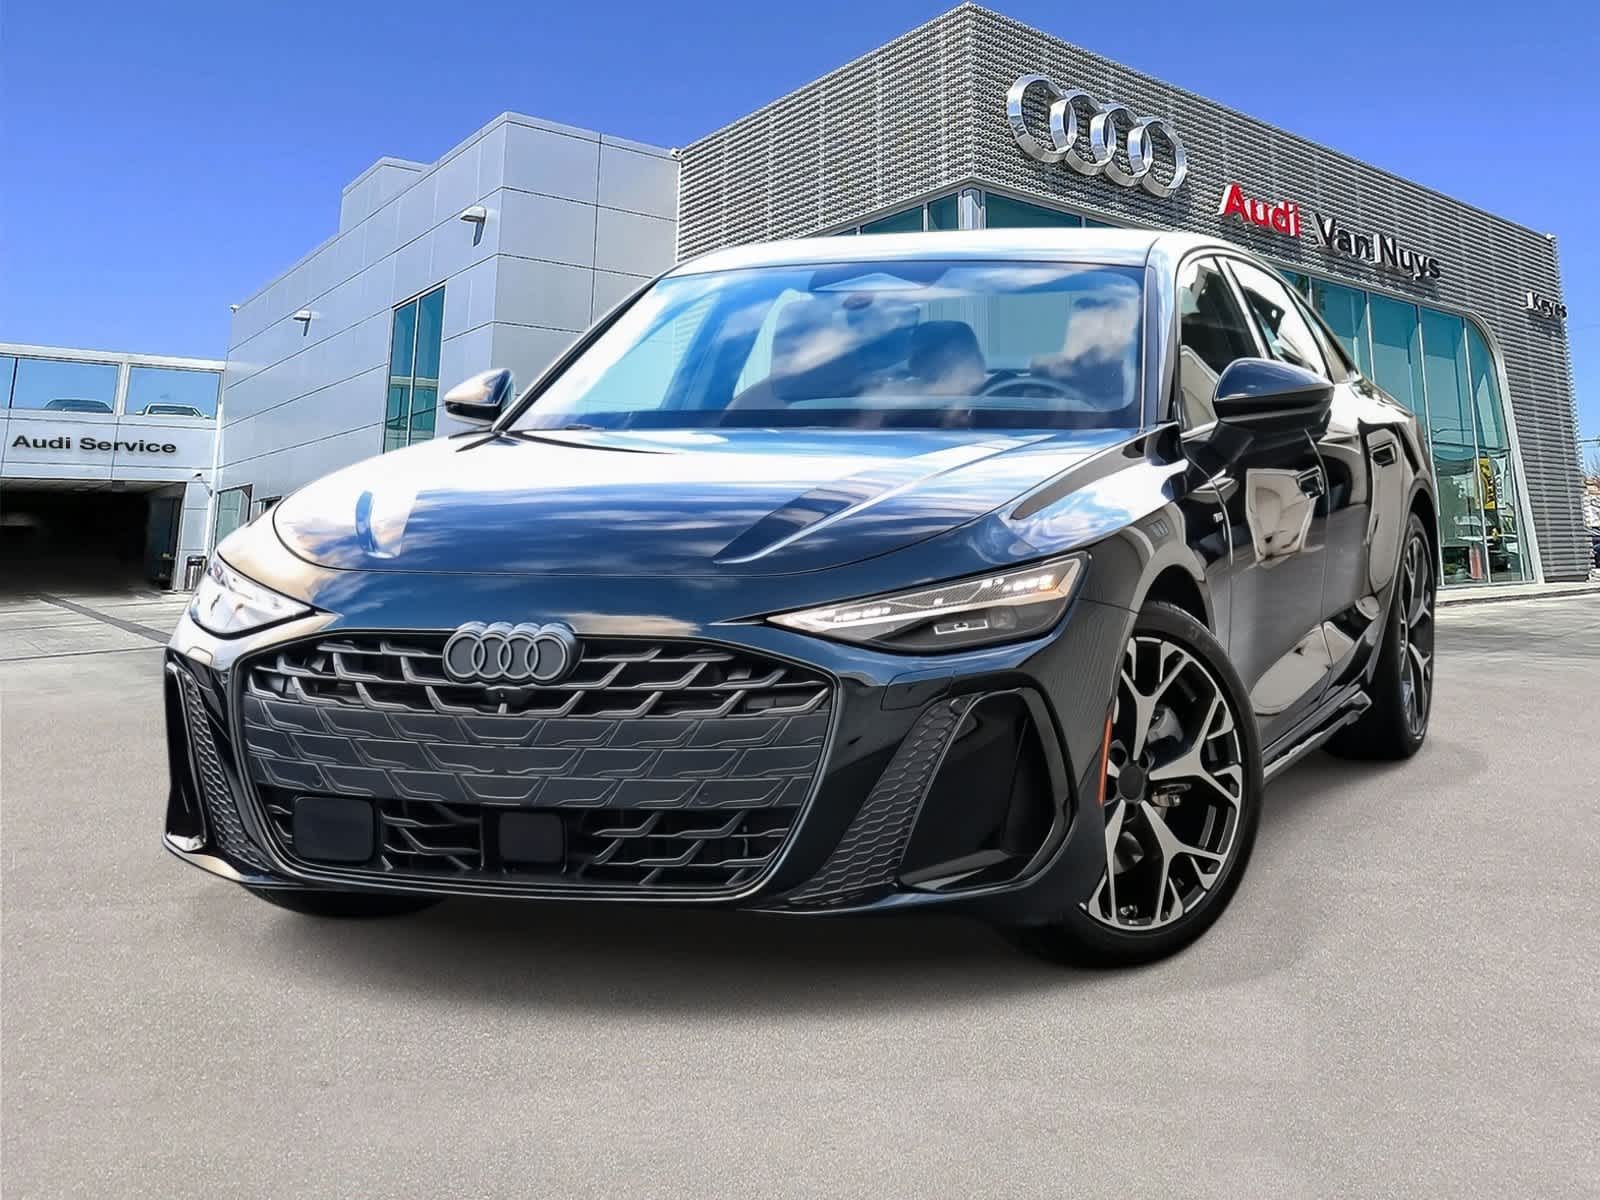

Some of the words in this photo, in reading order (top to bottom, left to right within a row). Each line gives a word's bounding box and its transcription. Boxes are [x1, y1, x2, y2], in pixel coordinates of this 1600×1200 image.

[1219, 182, 1302, 238] Audi
[1312, 213, 1371, 259] Van
[1374, 233, 1441, 280] Nuys
[12, 435, 71, 449] Audi
[79, 437, 177, 454] Service
